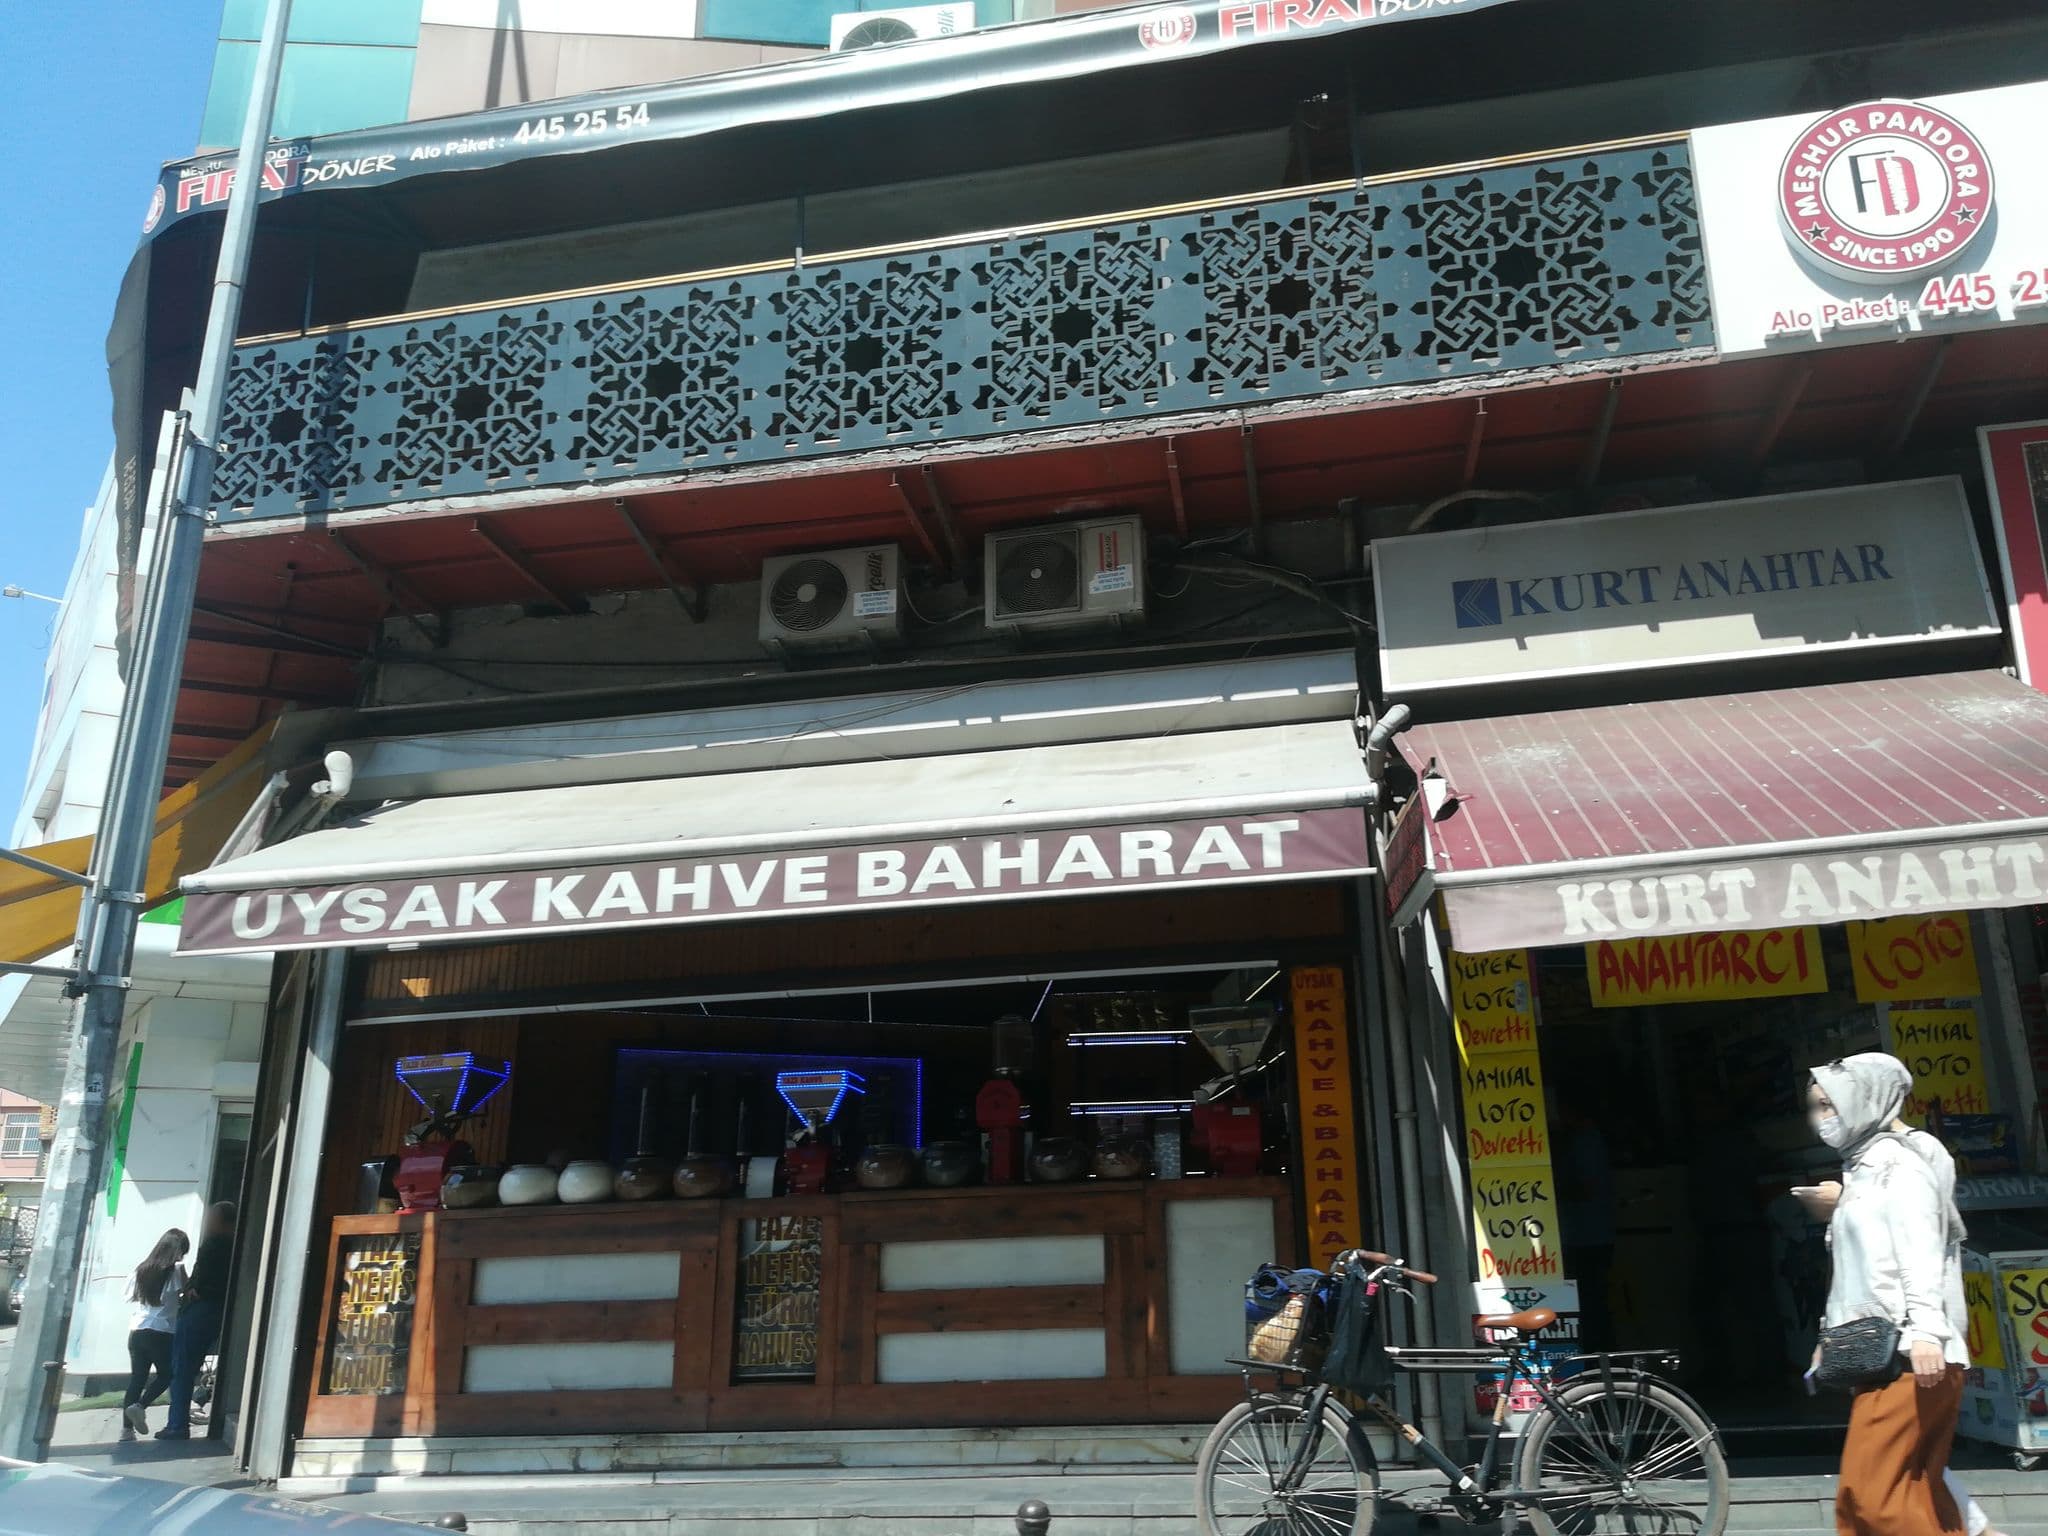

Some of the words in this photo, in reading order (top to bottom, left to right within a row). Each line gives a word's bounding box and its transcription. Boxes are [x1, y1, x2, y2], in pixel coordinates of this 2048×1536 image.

[410, 147, 441, 161] Alo
[513, 121, 566, 145] 445
[573, 111, 607, 137] 25
[616, 103, 650, 131] 54
[302, 154, 397, 185] DÖNER
[1792, 118, 1861, 217] MEŞHUR
[1867, 111, 1981, 199] PANDORA
[1829, 234, 1898, 265] SINCE
[1900, 227, 1955, 262] 1990
[1771, 311, 1812, 331] Alo
[1923, 274, 1996, 311] 445
[2016, 269, 2048, 302] 2
[1504, 565, 1663, 617] KURT
[1672, 543, 1894, 601] ANAHTAR
[231, 880, 508, 940] UYSAK
[532, 855, 829, 922] KAHVE
[857, 819, 1300, 898] BAHARAT
[1556, 868, 1757, 935] KURT
[1780, 841, 2048, 920] ANAHT
[1455, 953, 1523, 985] SÜPER
[1597, 928, 1809, 999] ANAHTARCI
[1863, 917, 1965, 989] LOTO
[1305, 999, 1337, 1091] KAHVE
[1461, 1016, 1531, 1049] Devretti
[1904, 1054, 1970, 1077] LOTO
[1479, 1098, 1536, 1123] LOTO
[1905, 1083, 1984, 1118] Deetti
[1470, 1125, 1544, 1161] Devretti
[1477, 1177, 1549, 1213] SÜPER
[1488, 1215, 1544, 1239] LOTO
[1482, 1245, 1557, 1279] Devretti
